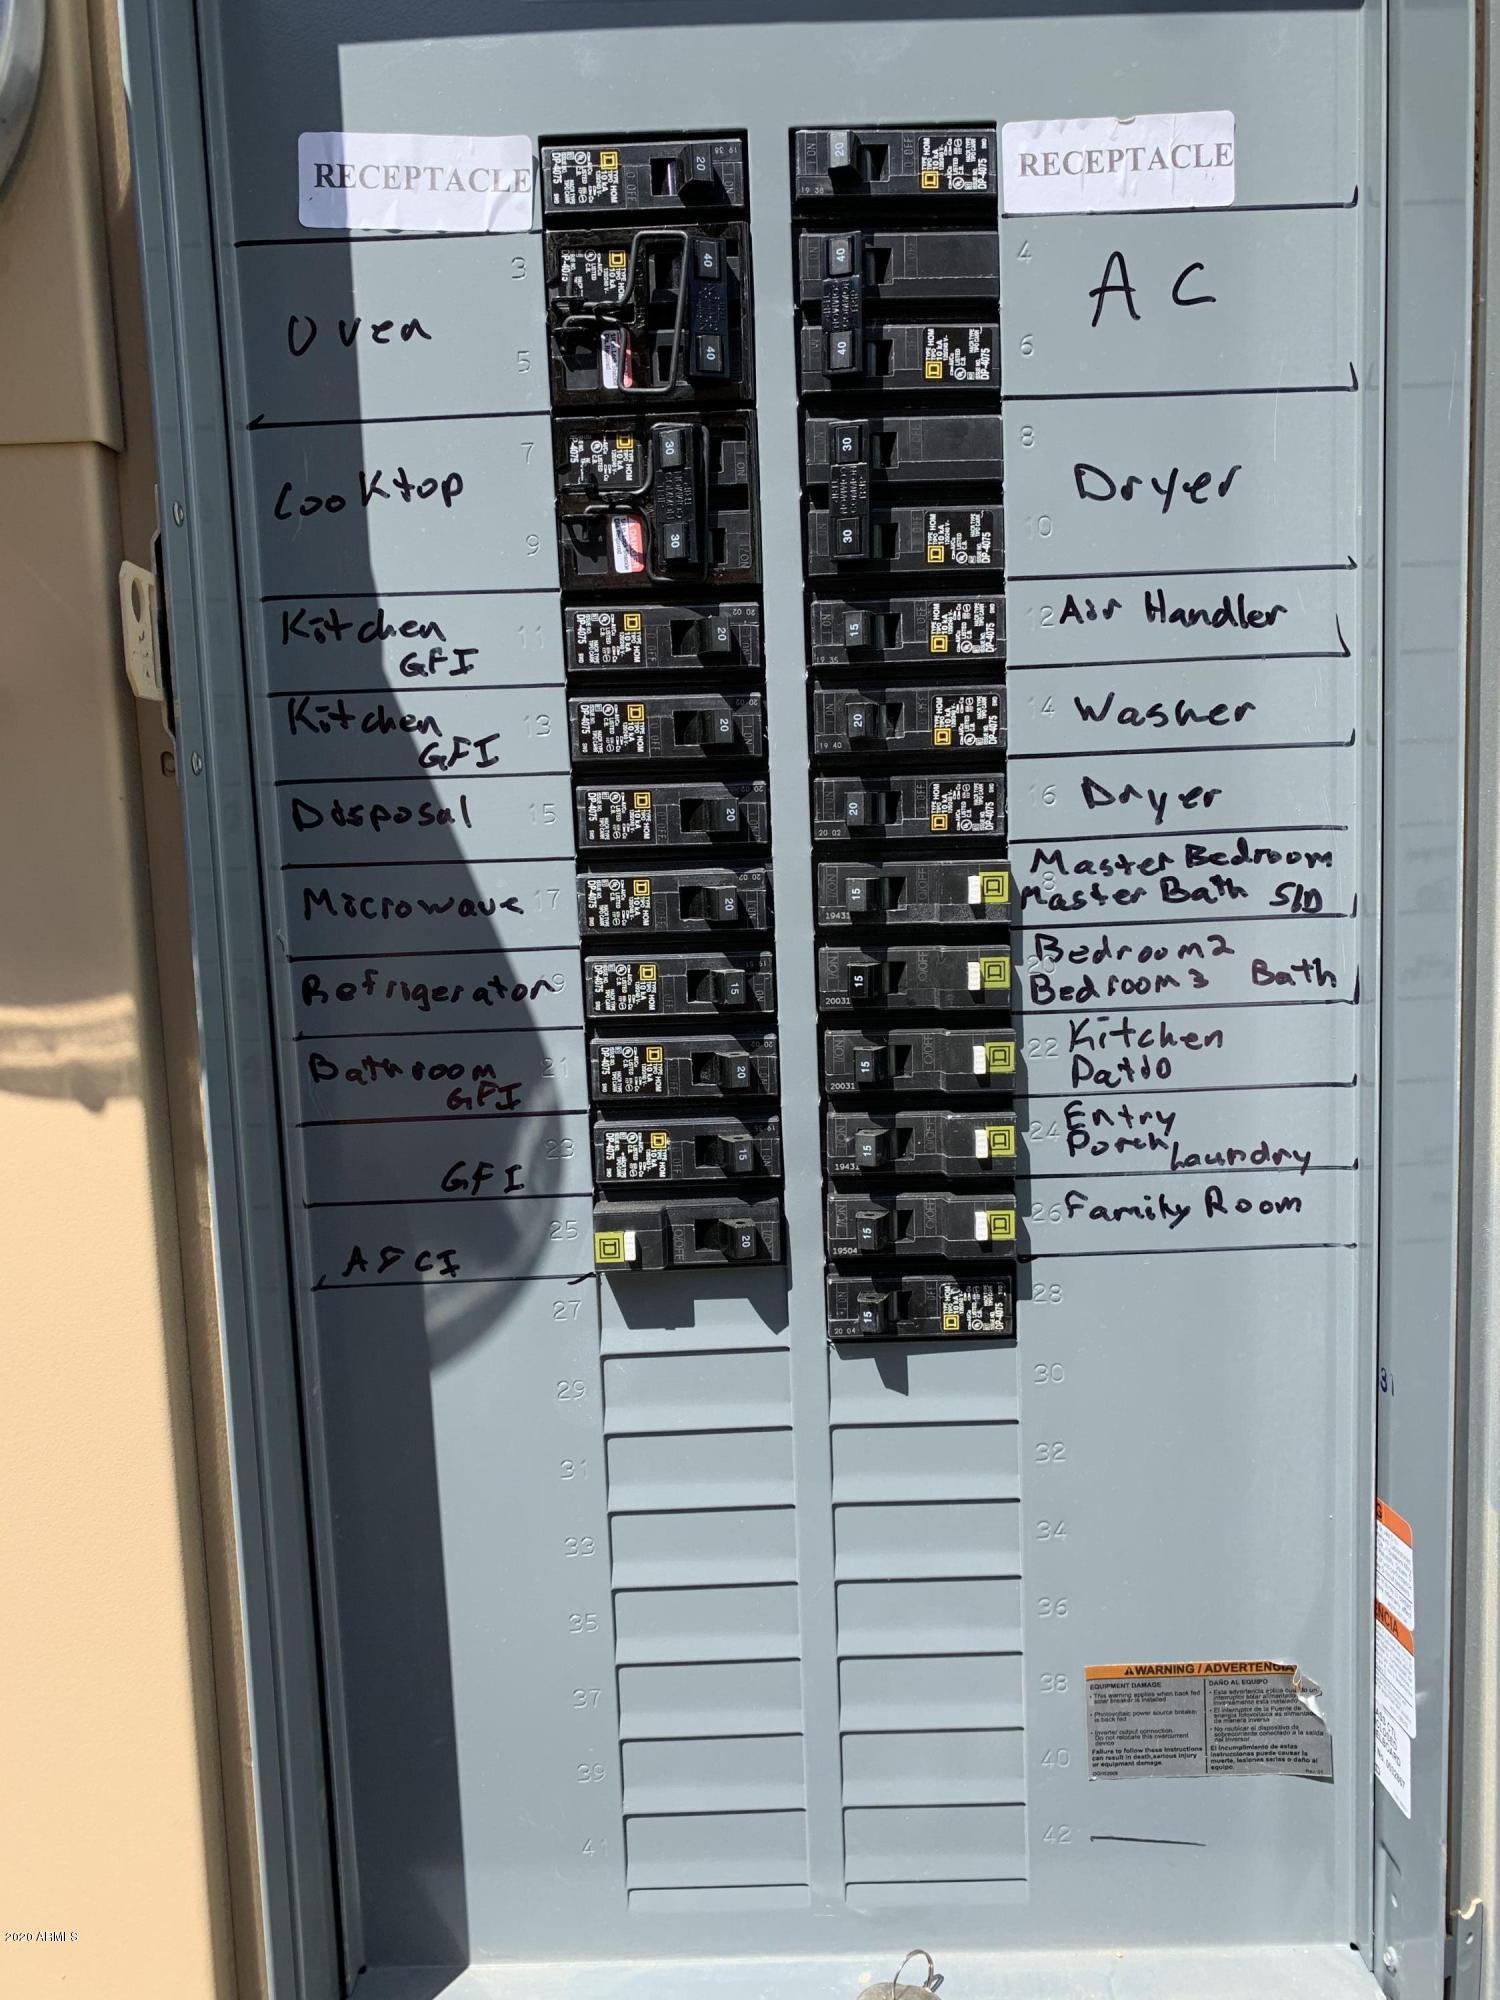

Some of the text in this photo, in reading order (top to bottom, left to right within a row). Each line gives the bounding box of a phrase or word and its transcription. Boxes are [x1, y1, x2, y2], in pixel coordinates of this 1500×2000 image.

[833, 141, 845, 158] 20
[1018, 142, 1234, 177] RECEPTACLE
[695, 154, 707, 172] 20
[314, 162, 531, 194] RECEPTACLE
[702, 252, 713, 269] 40
[835, 246, 847, 263] 40
[1017, 241, 1032, 264] 4
[511, 257, 527, 281] 3
[288, 315, 432, 356] Oven
[1019, 334, 1033, 356] 6
[705, 345, 716, 361] 40
[836, 340, 848, 356] 40
[516, 351, 531, 374] 5
[841, 436, 853, 453] 30
[1020, 425, 1035, 448] 8
[521, 442, 534, 464] 7
[664, 440, 675, 456] 30
[1074, 463, 1242, 514] Dryer
[841, 528, 853, 544] 30
[1027, 515, 1052, 539] 10
[525, 534, 540, 557] 9
[670, 532, 681, 549] 30
[1028, 606, 1056, 628] 12
[1059, 589, 1288, 629] Air Handler
[282, 608, 446, 645] Kitchen
[716, 626, 727, 642] 20
[849, 622, 860, 638] 15
[399, 647, 479, 677] GFI
[287, 696, 443, 737] Kitchen
[1028, 696, 1056, 718] 14
[1074, 692, 1256, 728] Washer
[523, 714, 552, 737] 13
[718, 717, 729, 733] 20
[852, 712, 864, 729] 20
[418, 733, 500, 771] GFI
[1030, 785, 1057, 806] 16
[1081, 776, 1222, 825] Dryer
[291, 795, 473, 832] Disposal
[529, 803, 557, 825] 15
[725, 807, 737, 823] 20
[847, 801, 859, 817] 20
[1030, 837, 1333, 877] Master Bedroom
[303, 887, 524, 921] Microwave
[533, 889, 560, 912] 17
[850, 886, 862, 901] 15
[1021, 882, 1147, 912] Master
[1160, 875, 1248, 904] Bath
[723, 897, 735, 912] 20
[1027, 956, 1056, 975] 20
[1252, 958, 1337, 988] Bath
[729, 982, 740, 996] 15
[853, 973, 864, 988] 15
[1069, 1016, 1223, 1052] Kitchen
[1028, 1039, 1059, 1059] 22
[309, 1052, 496, 1086] Bathroom
[541, 1058, 569, 1078] 21
[736, 1065, 747, 1080] 20
[860, 1059, 871, 1074] 15
[1072, 1054, 1172, 1089] Patio
[446, 1081, 522, 1111] GFI
[1064, 1101, 1176, 1136] Entry
[1030, 1121, 1060, 1142] 24
[545, 1138, 575, 1159] 23
[738, 1148, 749, 1162] 15
[861, 1143, 873, 1157] 15
[1066, 1129, 1311, 1175] Porch Laundry
[441, 1161, 525, 1196] GFI
[1031, 1203, 1062, 1224] 26
[1064, 1185, 1302, 1229] Family Room
[550, 1221, 578, 1241] 25
[741, 1234, 752, 1249] 20
[861, 1226, 873, 1240] 15
[1033, 1284, 1063, 1305] 28
[553, 1301, 582, 1321] 27
[862, 1310, 873, 1324] 15
[1034, 1363, 1065, 1384] 30
[557, 1381, 585, 1400] 29
[1034, 1442, 1067, 1462] 32
[560, 1460, 588, 1480] 31
[1036, 1520, 1068, 1541] 34
[564, 1536, 596, 1557] 33
[1037, 1597, 1069, 1618] 36
[569, 1614, 599, 1634] 35
[1135, 1664, 1195, 1676] WARNING
[1039, 1673, 1069, 1693] 38
[1090, 1683, 1130, 1691] EQUIPMENT
[573, 1690, 601, 1709] 37
[1042, 1749, 1071, 1769] 40
[577, 1765, 607, 1783] 39
[1042, 1825, 1073, 1845] 42
